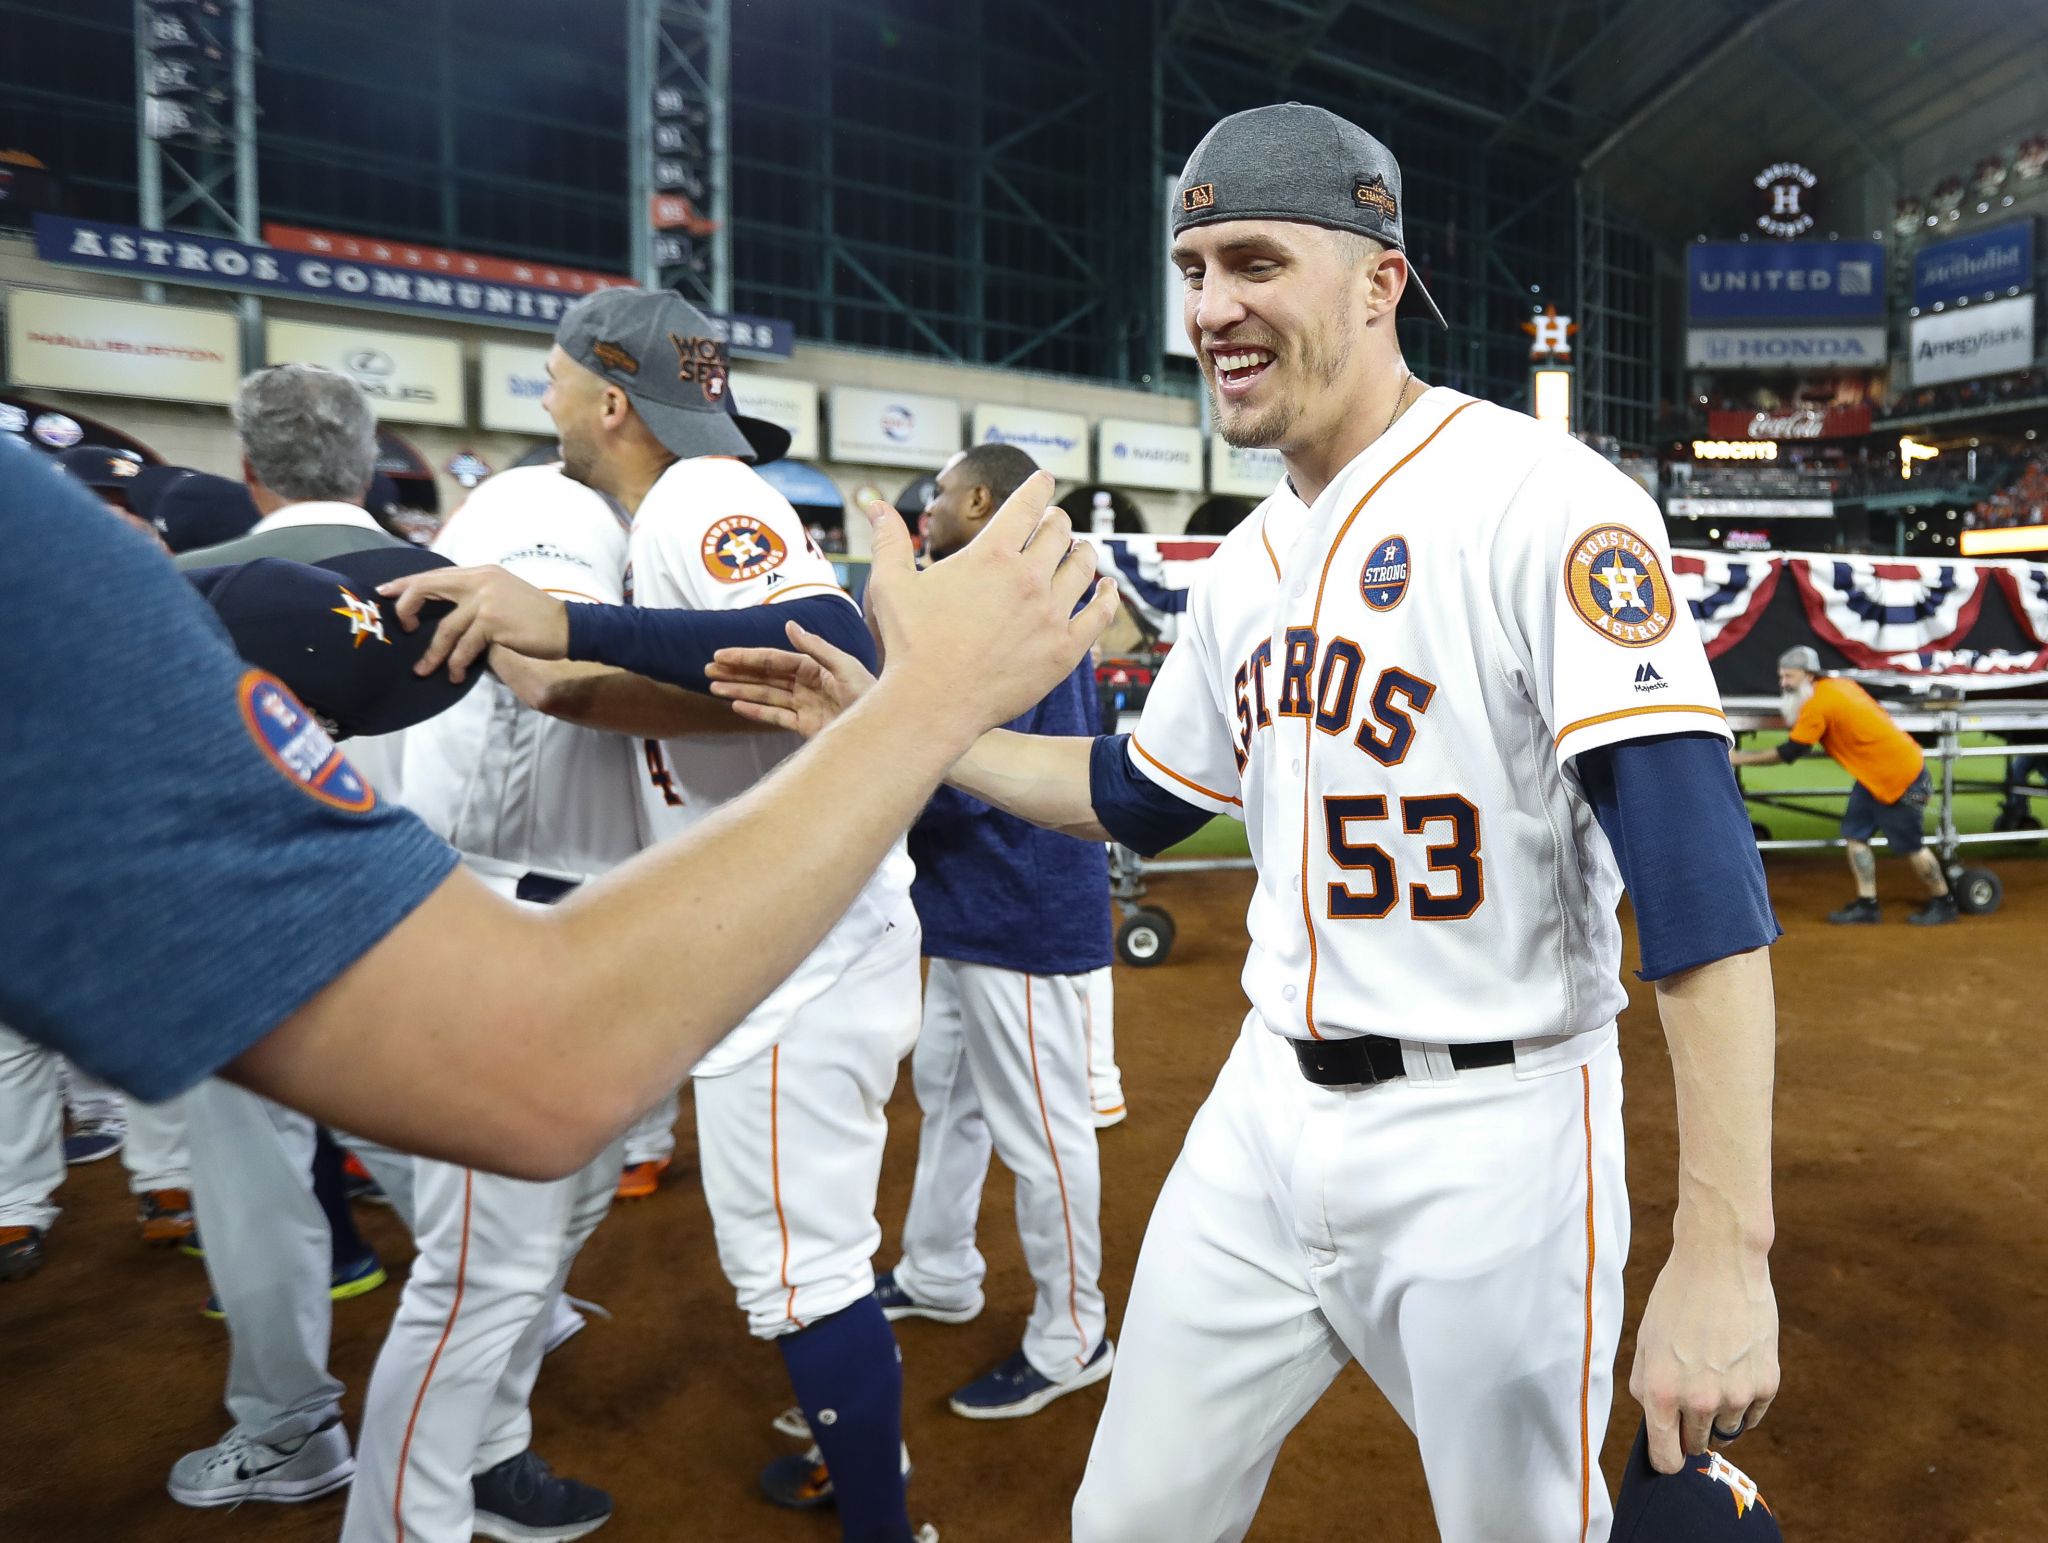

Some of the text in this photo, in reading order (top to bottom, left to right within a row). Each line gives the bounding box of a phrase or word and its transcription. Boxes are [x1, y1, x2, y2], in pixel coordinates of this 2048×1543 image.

[1772, 185, 1800, 214] H
[70, 227, 283, 282] ASTROS
[1699, 270, 1831, 292] UNITED
[1531, 315, 1573, 353] H
[1738, 337, 1864, 356] HONDA
[704, 517, 760, 555] HOUSTON
[1576, 531, 1654, 566] HOUSTON
[730, 549, 784, 580] ASTROS
[1364, 563, 1407, 583] STRONG
[1596, 612, 1667, 641] ASTROS
[1634, 681, 1669, 694] Majestic
[1322, 793, 1485, 921] 53
